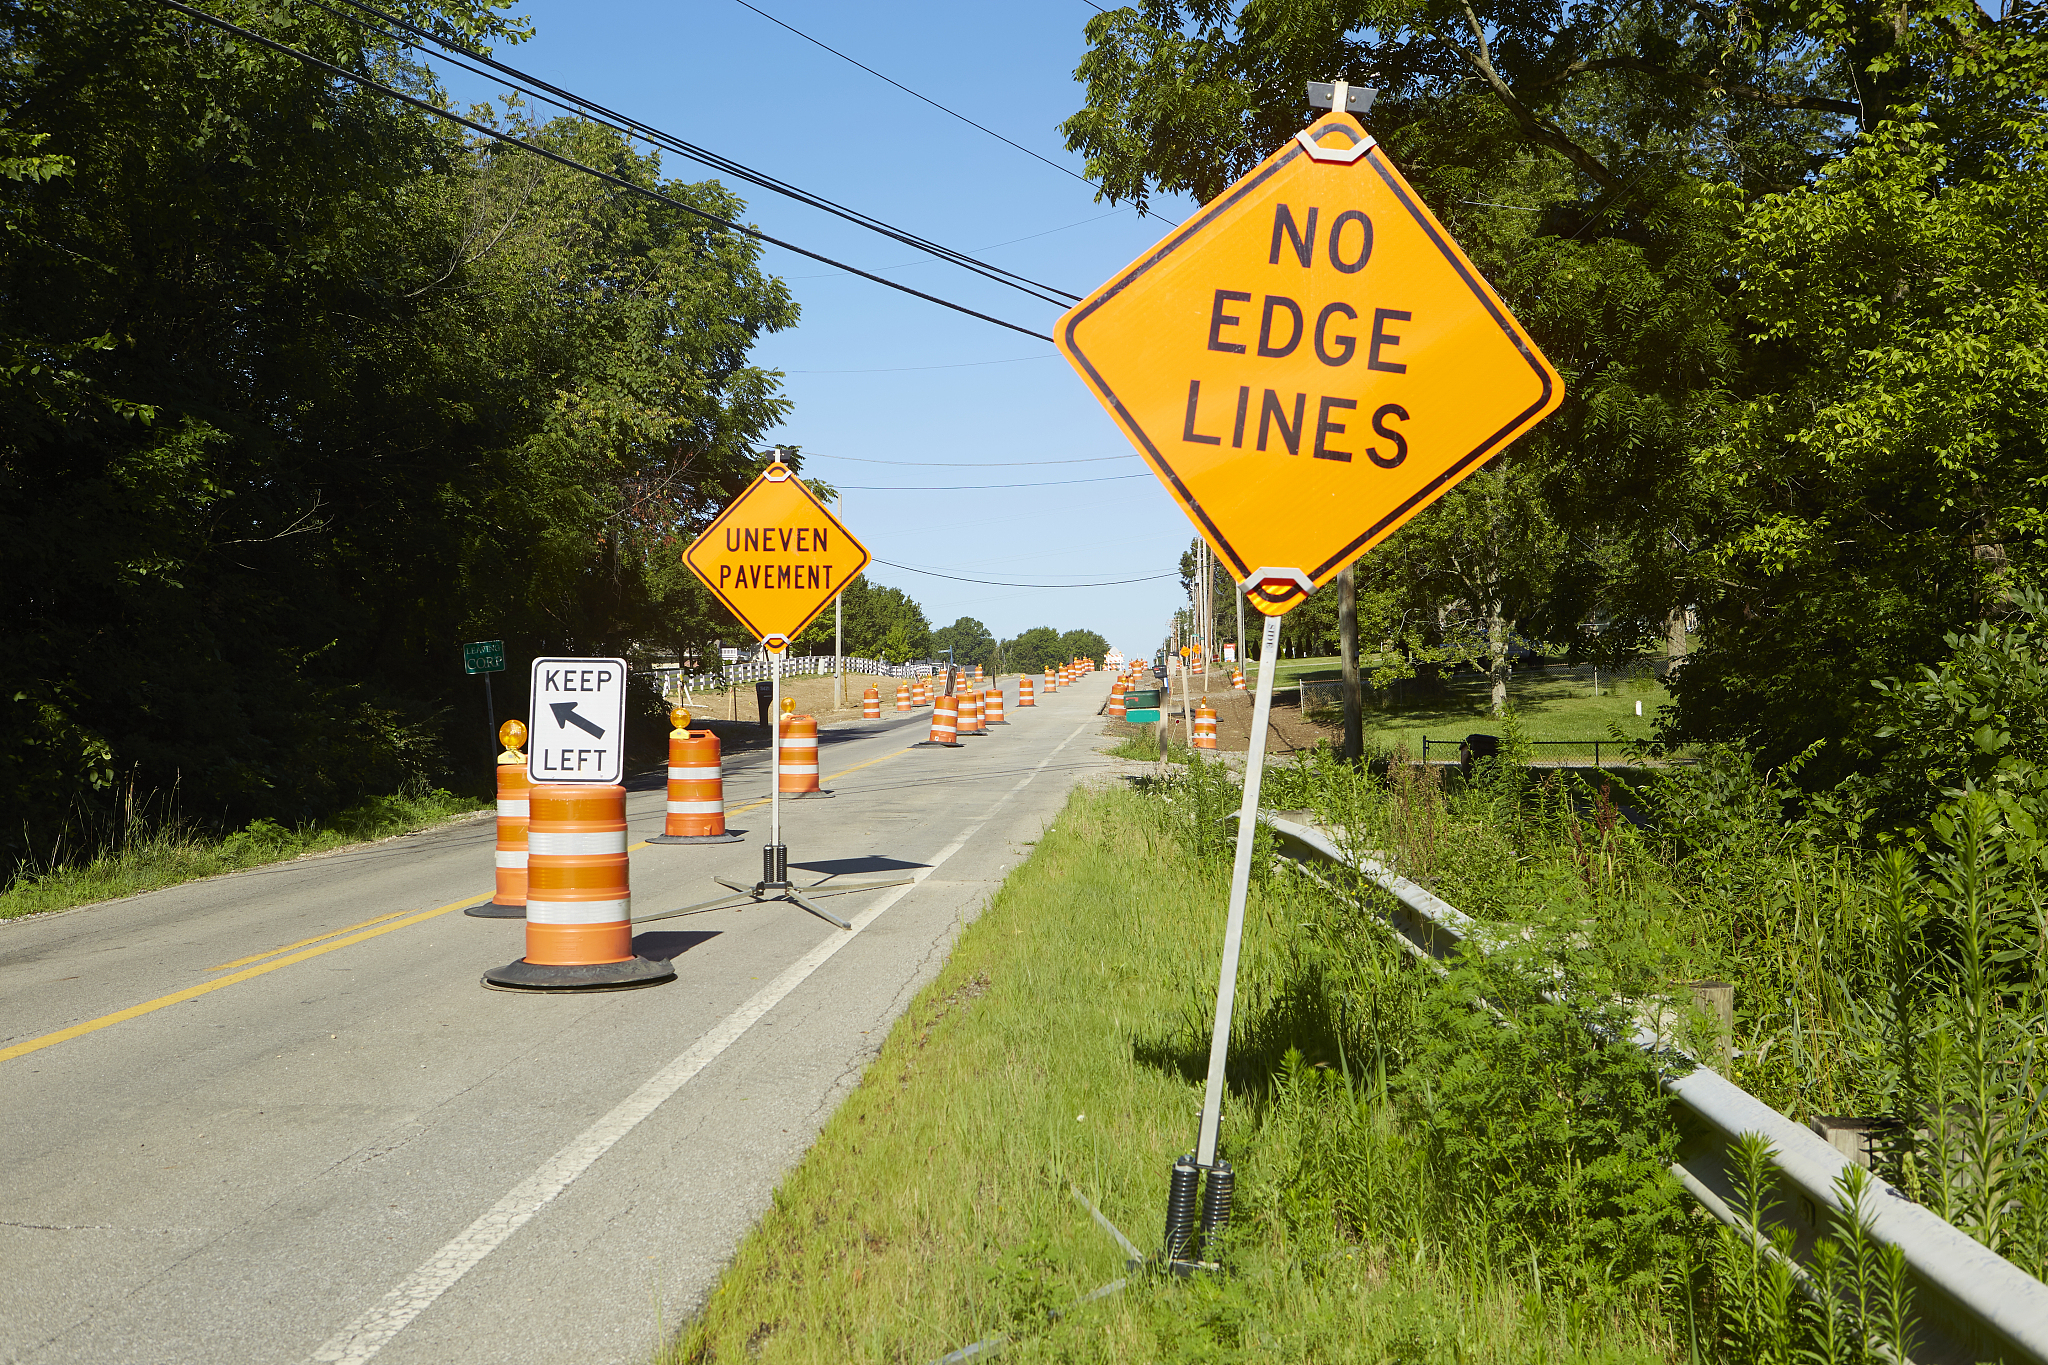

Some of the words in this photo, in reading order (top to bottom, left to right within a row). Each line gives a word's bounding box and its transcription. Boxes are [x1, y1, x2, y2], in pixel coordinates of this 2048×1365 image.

[1269, 203, 1374, 274] NO
[1208, 289, 1412, 374] EDGE
[1182, 380, 1410, 469] LINES
[726, 528, 828, 552] UNEVEN
[719, 565, 833, 589] PAVEMENT
[1266, 624, 1275, 649] SIDE
[466, 644, 501, 655] LEAVING
[467, 655, 503, 670] CORP
[545, 669, 612, 692] KEEP
[543, 748, 607, 771] LEFT
